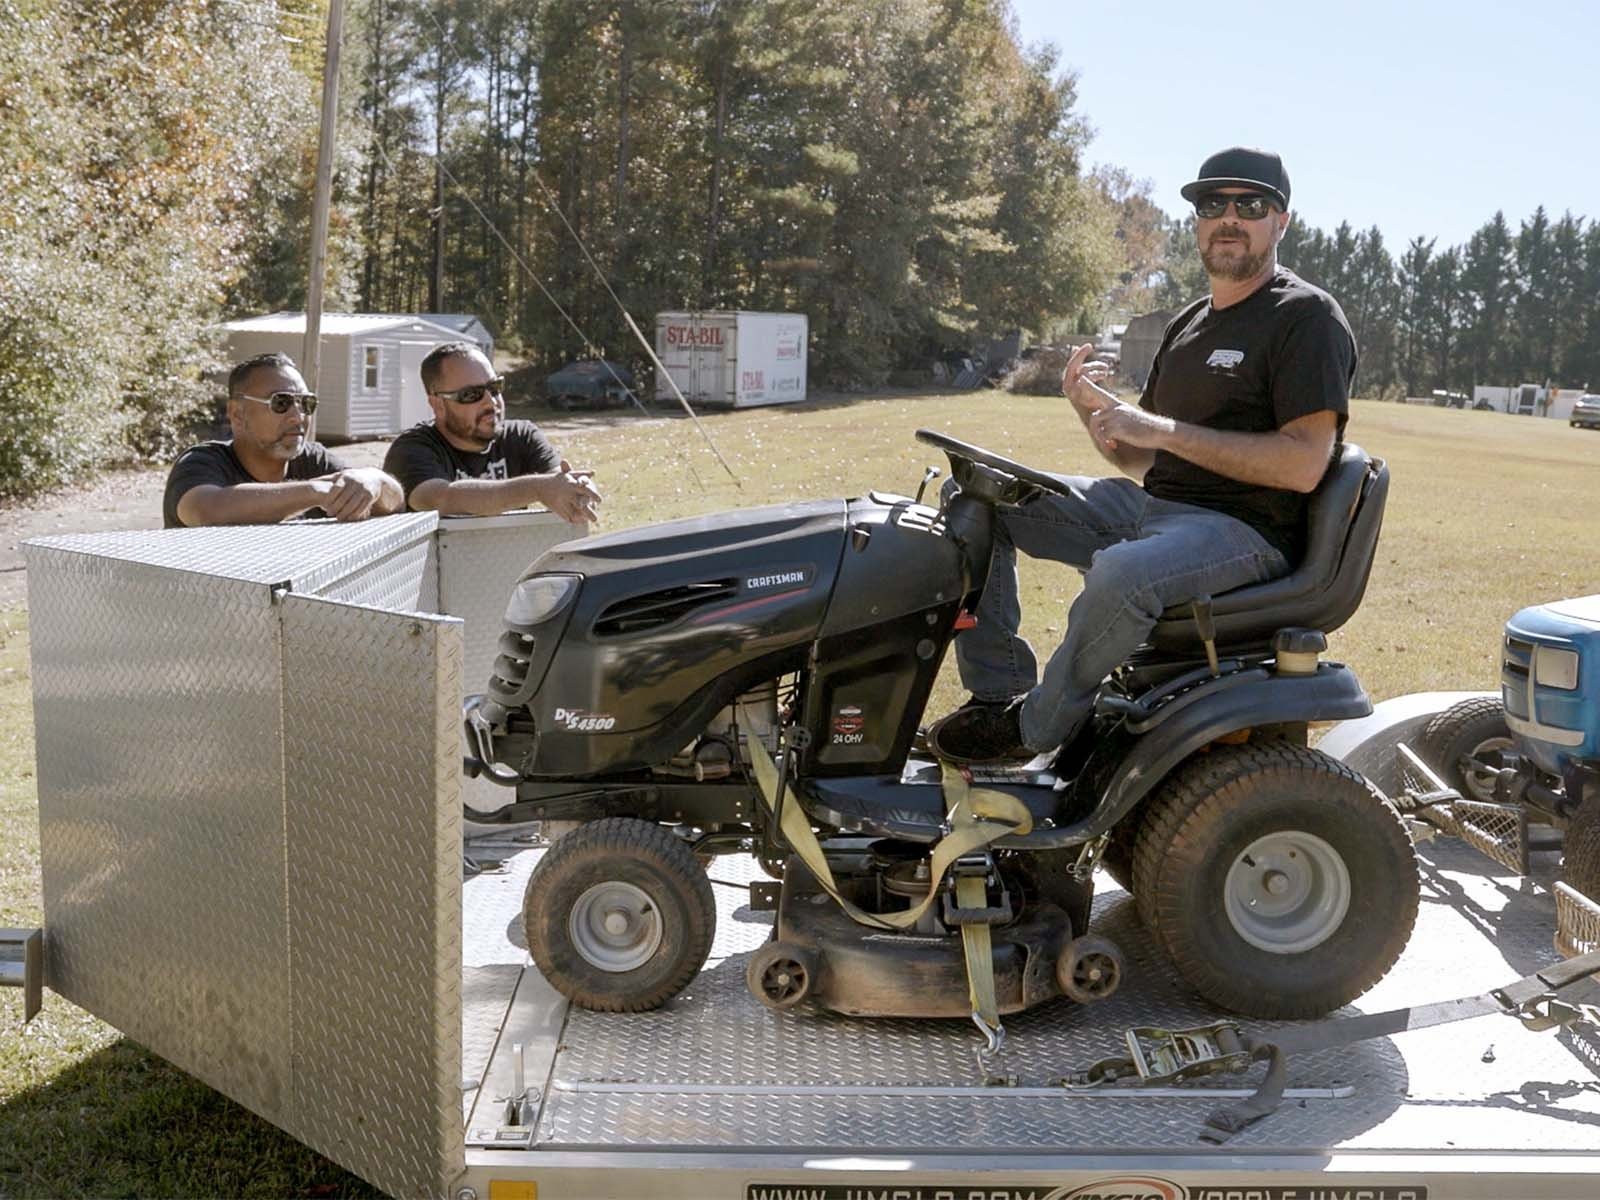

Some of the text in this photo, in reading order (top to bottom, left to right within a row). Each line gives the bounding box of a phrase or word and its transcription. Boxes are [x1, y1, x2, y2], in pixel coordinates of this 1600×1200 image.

[667, 326, 724, 345] STA-BIL
[747, 571, 804, 589] CRAFTSMAN
[833, 734, 863, 744] 24 OHV
